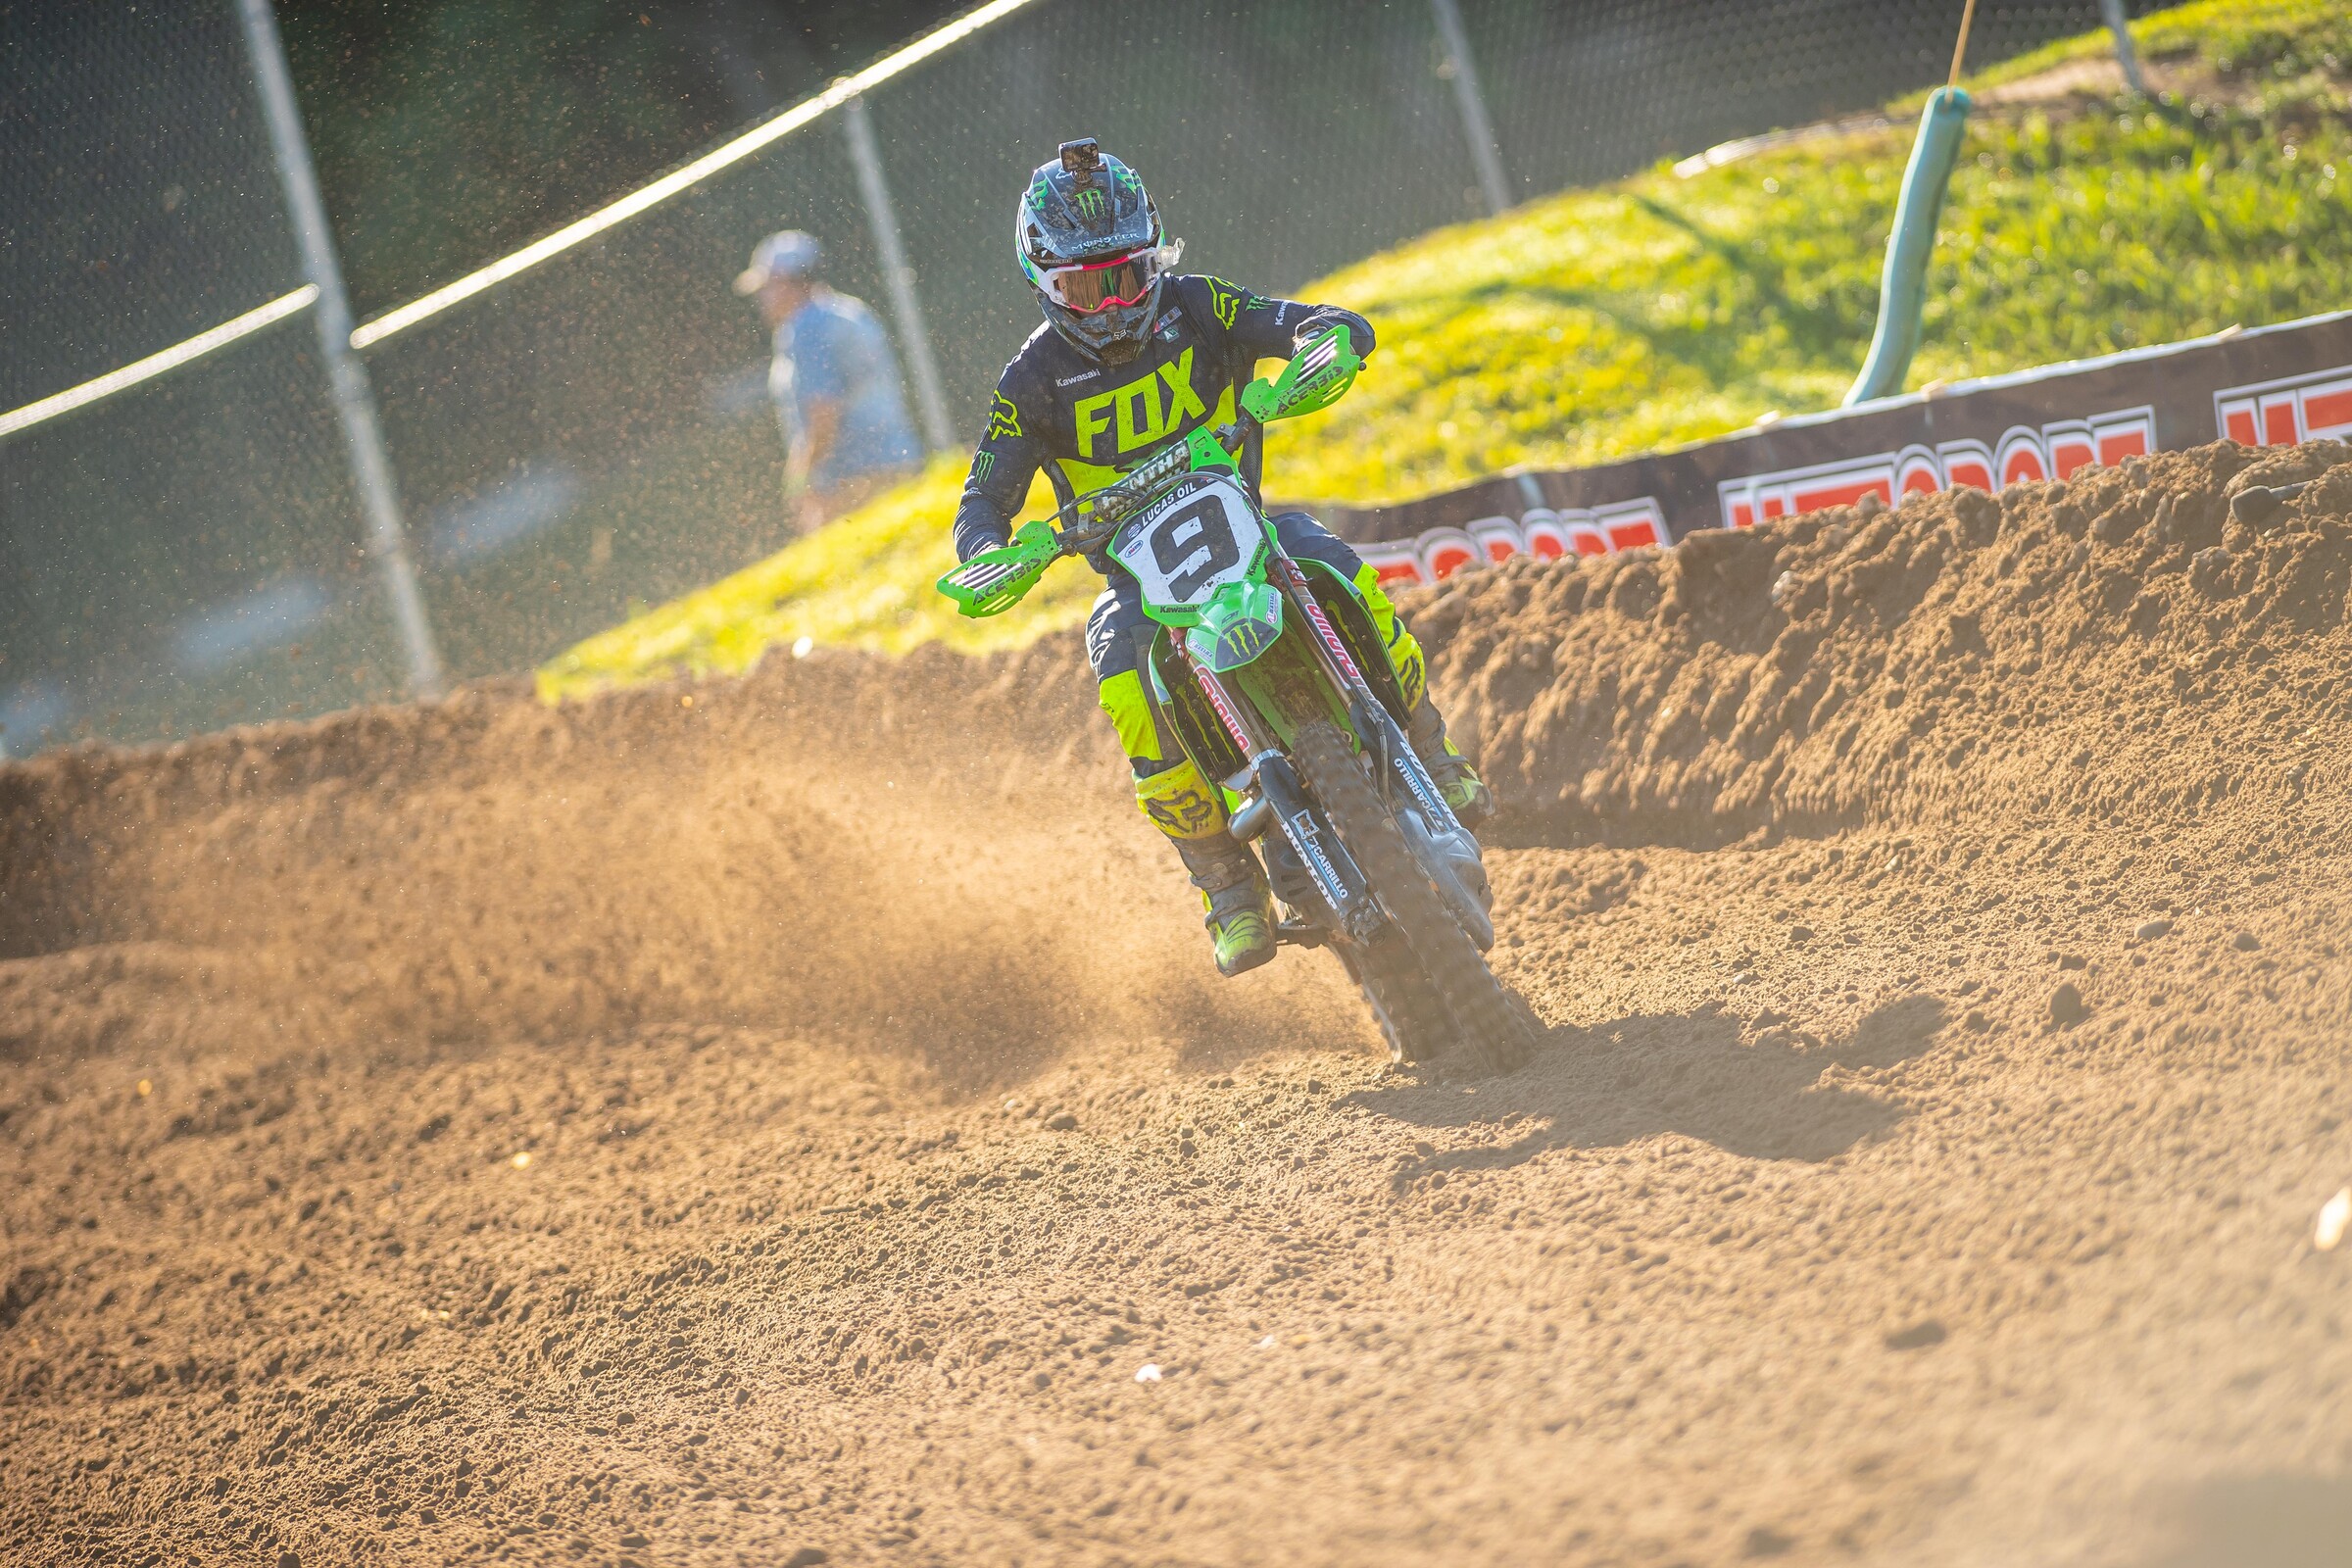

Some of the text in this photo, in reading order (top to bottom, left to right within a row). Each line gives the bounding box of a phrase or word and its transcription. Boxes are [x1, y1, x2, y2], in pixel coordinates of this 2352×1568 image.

[1055, 368, 1101, 387] Kawasaki
[1075, 345, 1206, 458] FOX
[1276, 366, 1344, 416] ACERBIS
[1142, 493, 1174, 527] LUCAS
[1177, 482, 1197, 498] OIL
[1151, 495, 1240, 603] 9
[972, 558, 1042, 606] ACERBIS
[1394, 758, 1431, 808] CARRILLO
[1313, 846, 1348, 899] CARRILLO
